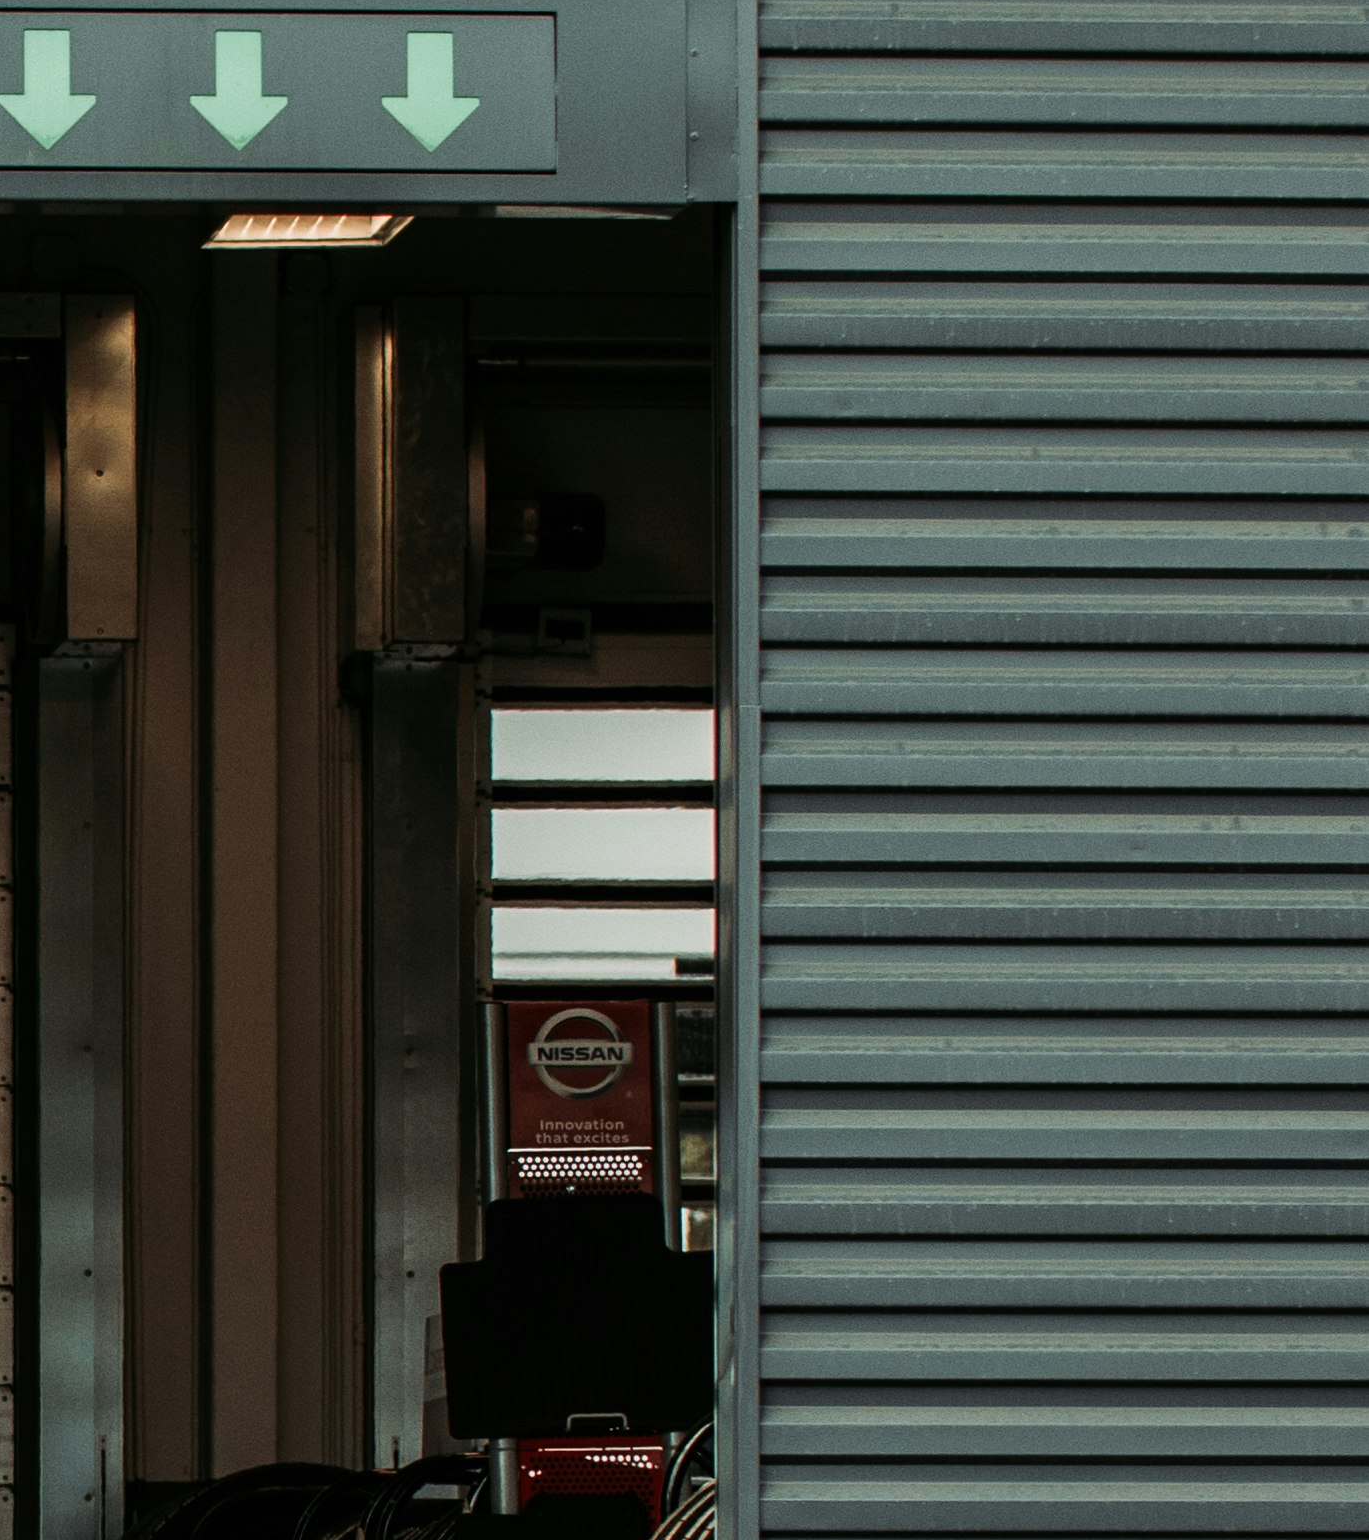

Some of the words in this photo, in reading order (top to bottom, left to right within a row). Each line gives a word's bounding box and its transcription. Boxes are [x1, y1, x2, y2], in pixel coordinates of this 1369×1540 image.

[537, 1045, 625, 1061] NISSAN
[539, 1119, 625, 1132] Innovation
[535, 1131, 569, 1144] that
[573, 1133, 629, 1144] excites
